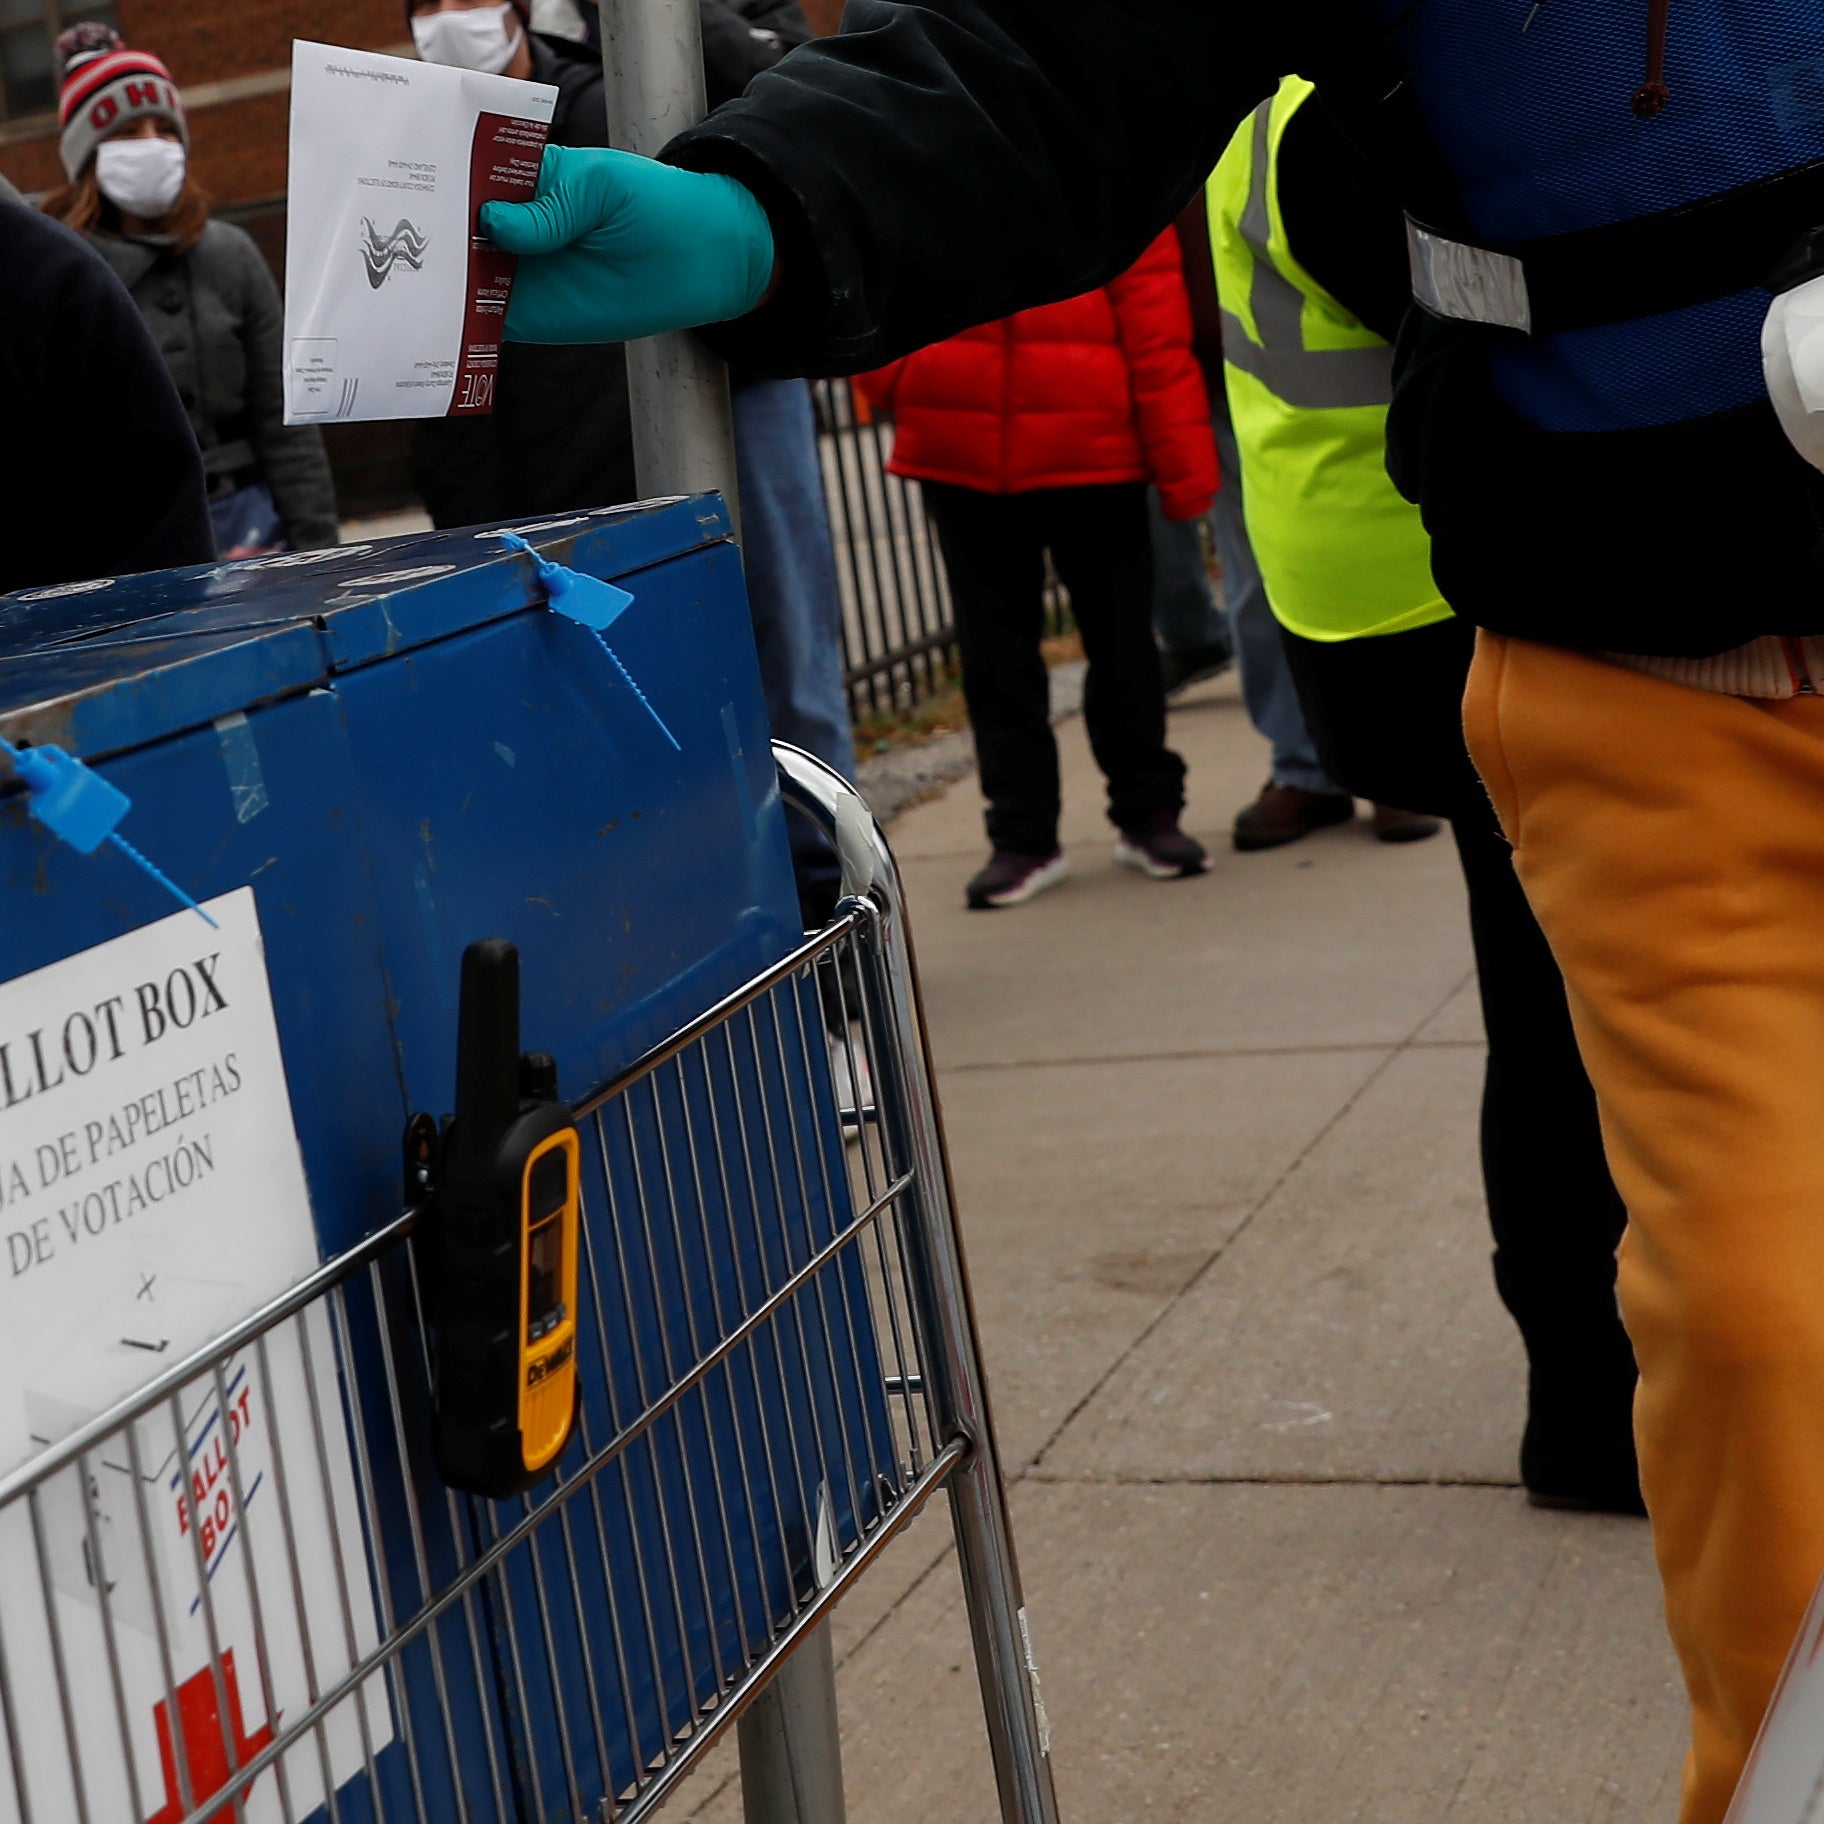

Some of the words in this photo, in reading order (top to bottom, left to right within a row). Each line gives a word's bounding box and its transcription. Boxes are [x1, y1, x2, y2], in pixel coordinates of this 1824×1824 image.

[90, 80, 176, 129] OHI
[457, 374, 494, 408] VOTE
[132, 952, 231, 1046] BOX
[34, 1131, 83, 1189] DE
[83, 1052, 243, 1165] PAPELETAS
[5, 1216, 55, 1278] DE
[56, 1133, 216, 1244] VOTACIÓN
[200, 1476, 242, 1562] BO
